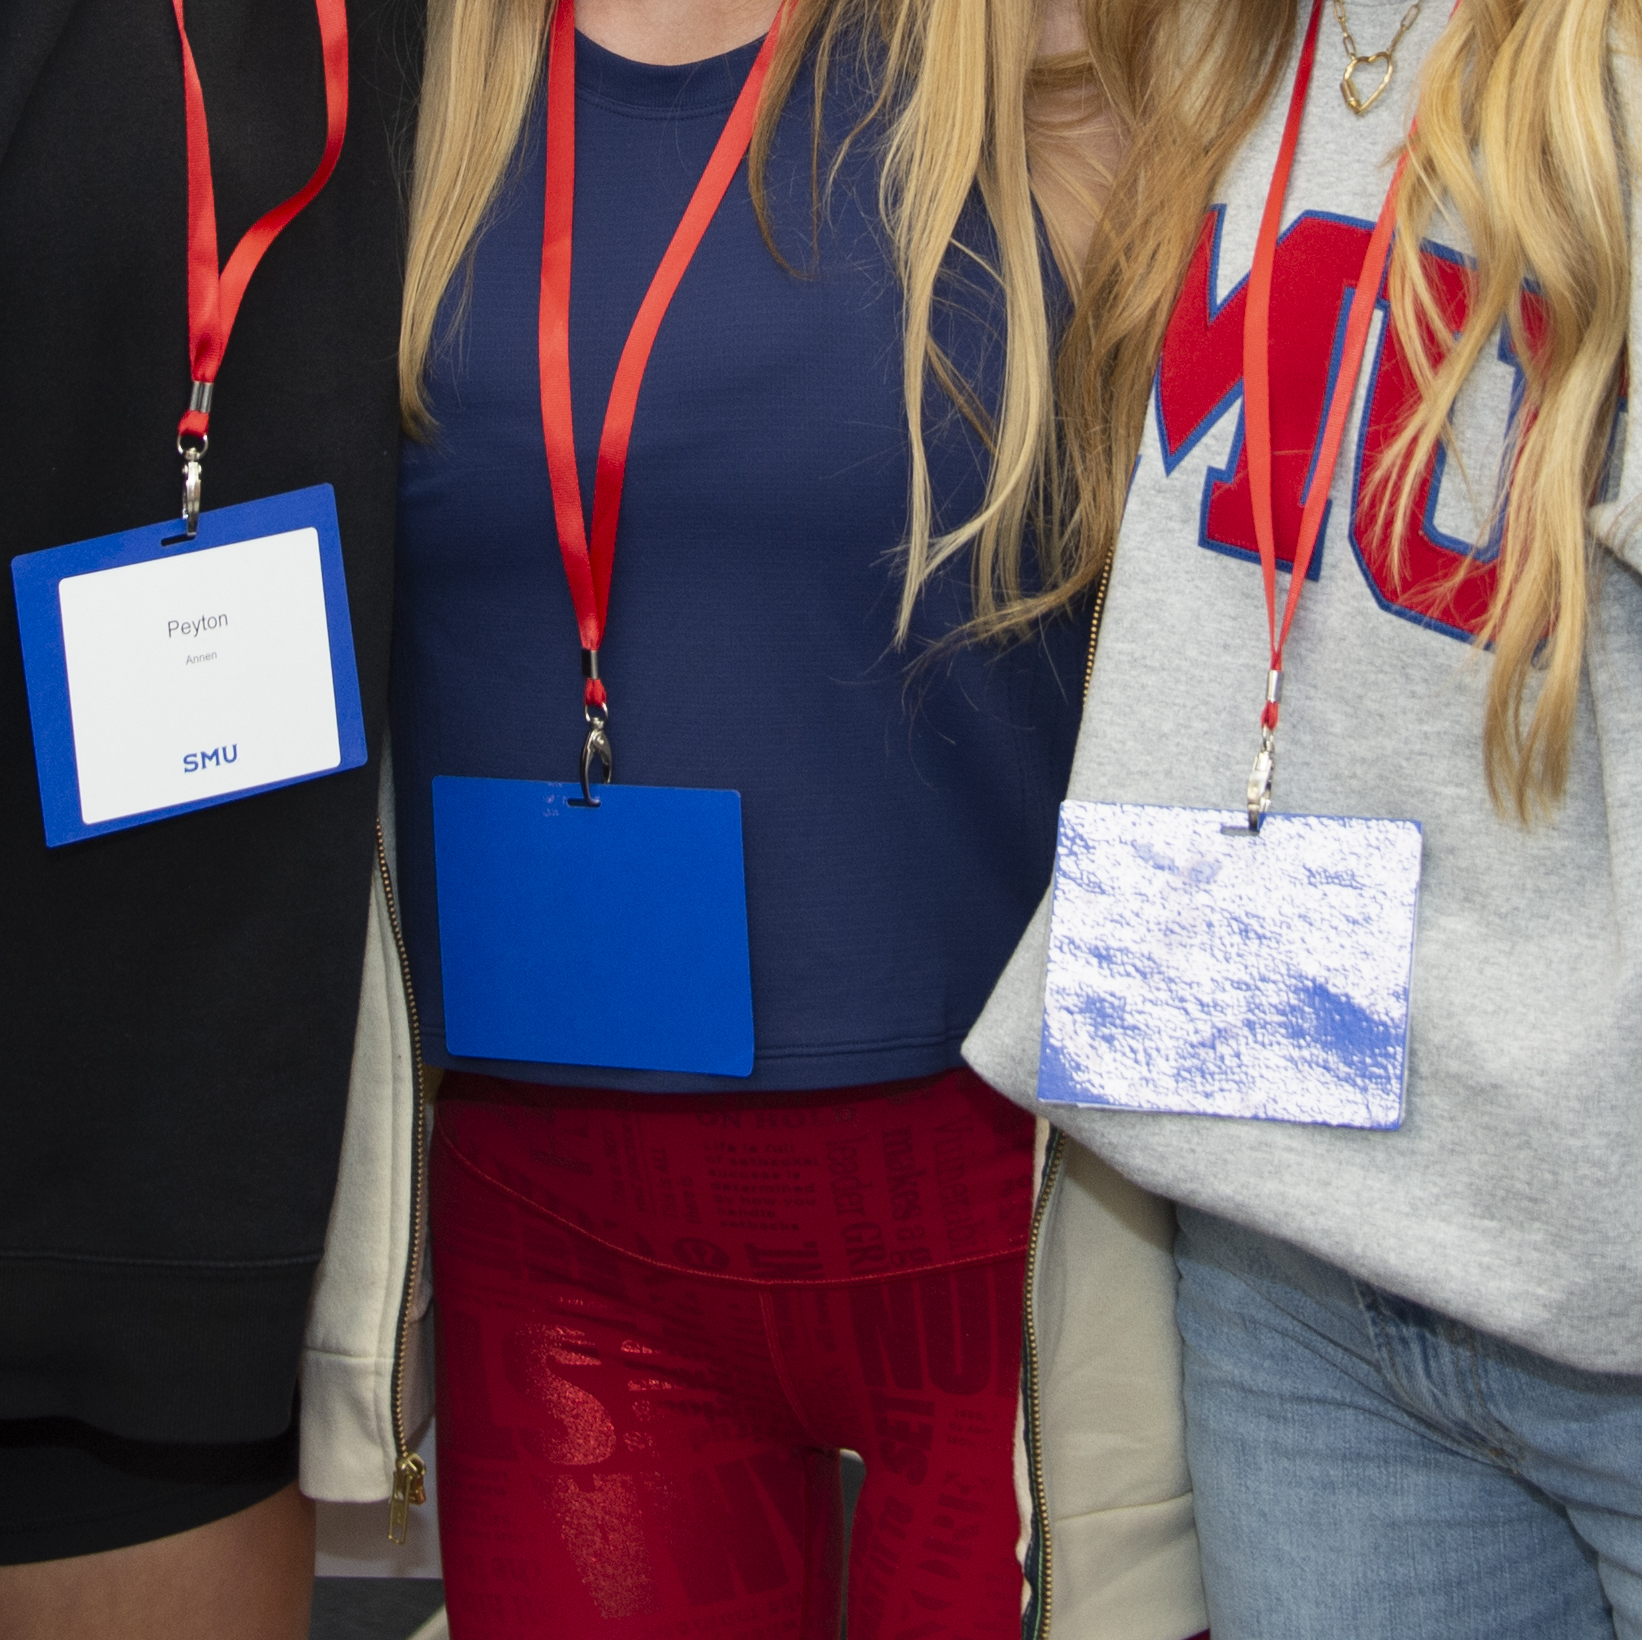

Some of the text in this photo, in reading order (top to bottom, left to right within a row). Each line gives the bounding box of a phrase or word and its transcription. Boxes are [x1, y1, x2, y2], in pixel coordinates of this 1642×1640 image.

[1122, 202, 1629, 660] MU
[167, 613, 229, 638] Peyton
[185, 651, 218, 666] Annen
[182, 743, 238, 773] SMU
[826, 1132, 874, 1217] leader
[882, 1125, 927, 1221] makes
